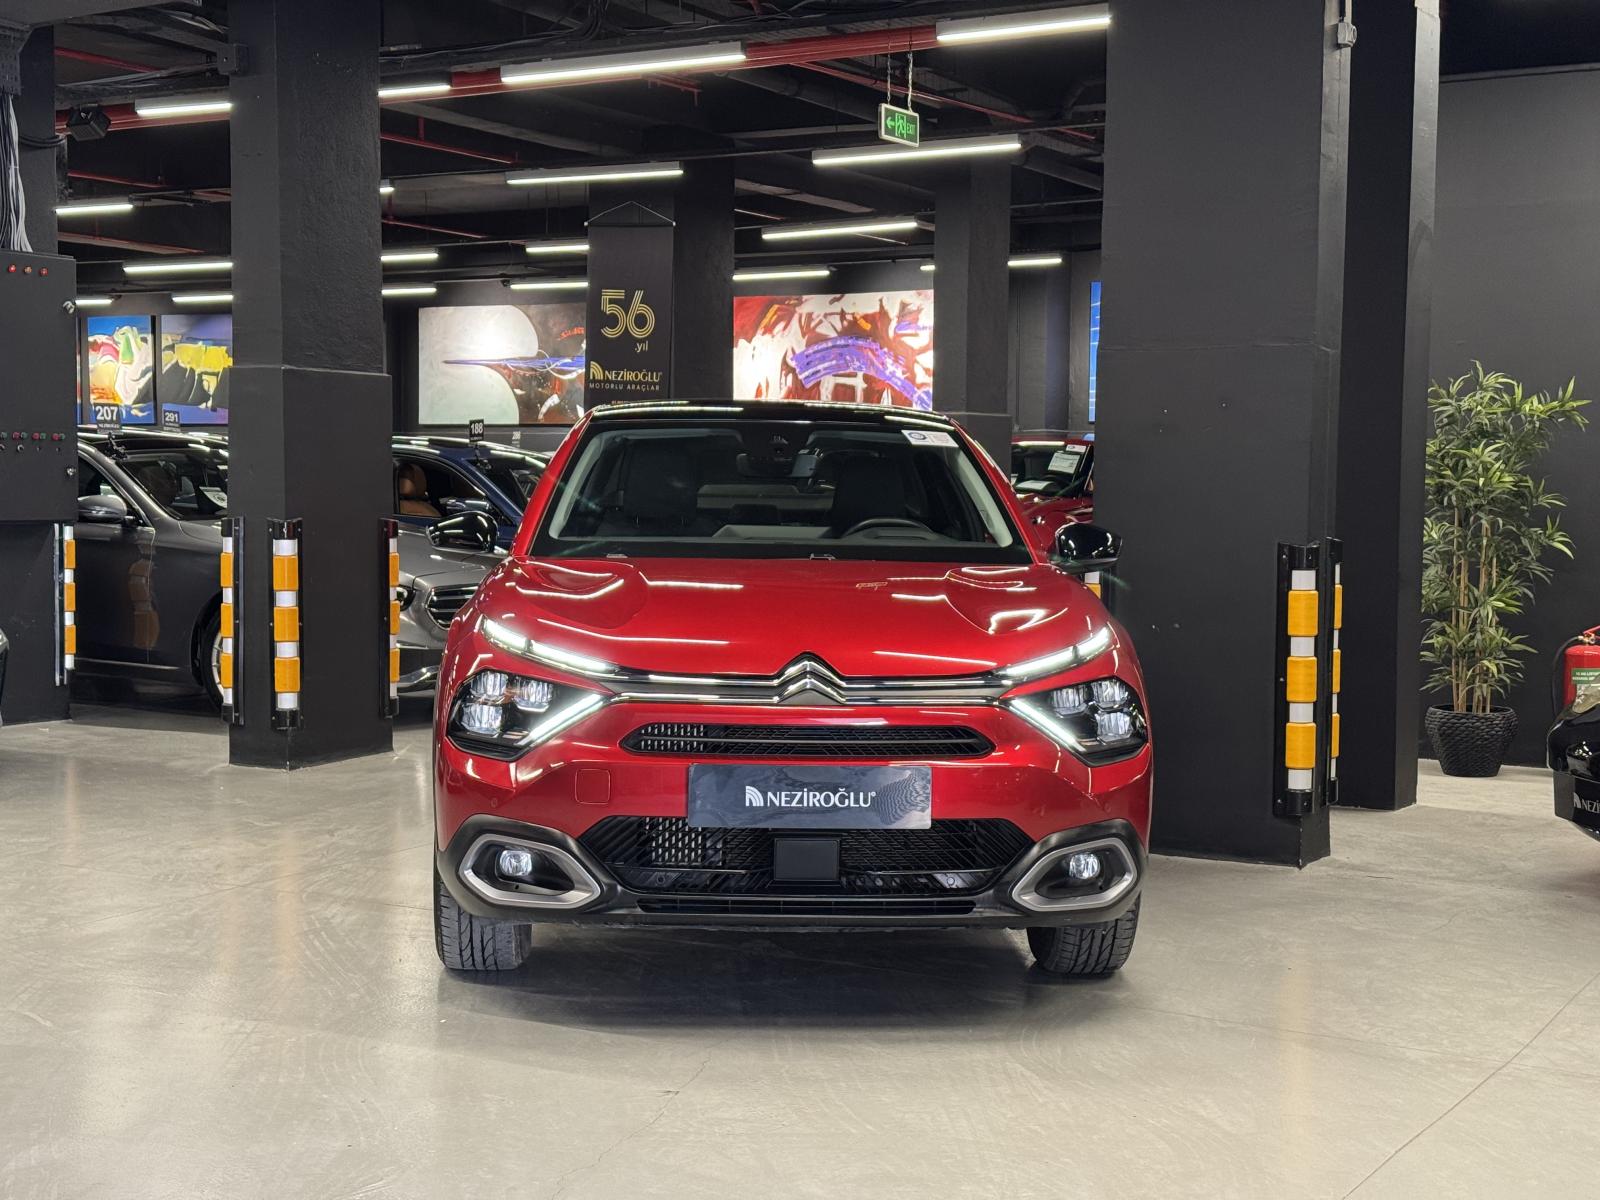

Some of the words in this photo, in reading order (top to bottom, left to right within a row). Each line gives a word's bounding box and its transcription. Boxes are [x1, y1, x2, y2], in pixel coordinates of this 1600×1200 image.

[601, 289, 656, 338] 56
[604, 368, 661, 383] NEZİROĞLU
[589, 382, 624, 391] MOTORLU
[626, 383, 661, 393] ARAÇLAR
[95, 405, 119, 422] 207
[164, 411, 179, 423] 291
[470, 422, 484, 435] 188
[1581, 798, 1600, 814] NEZİ
